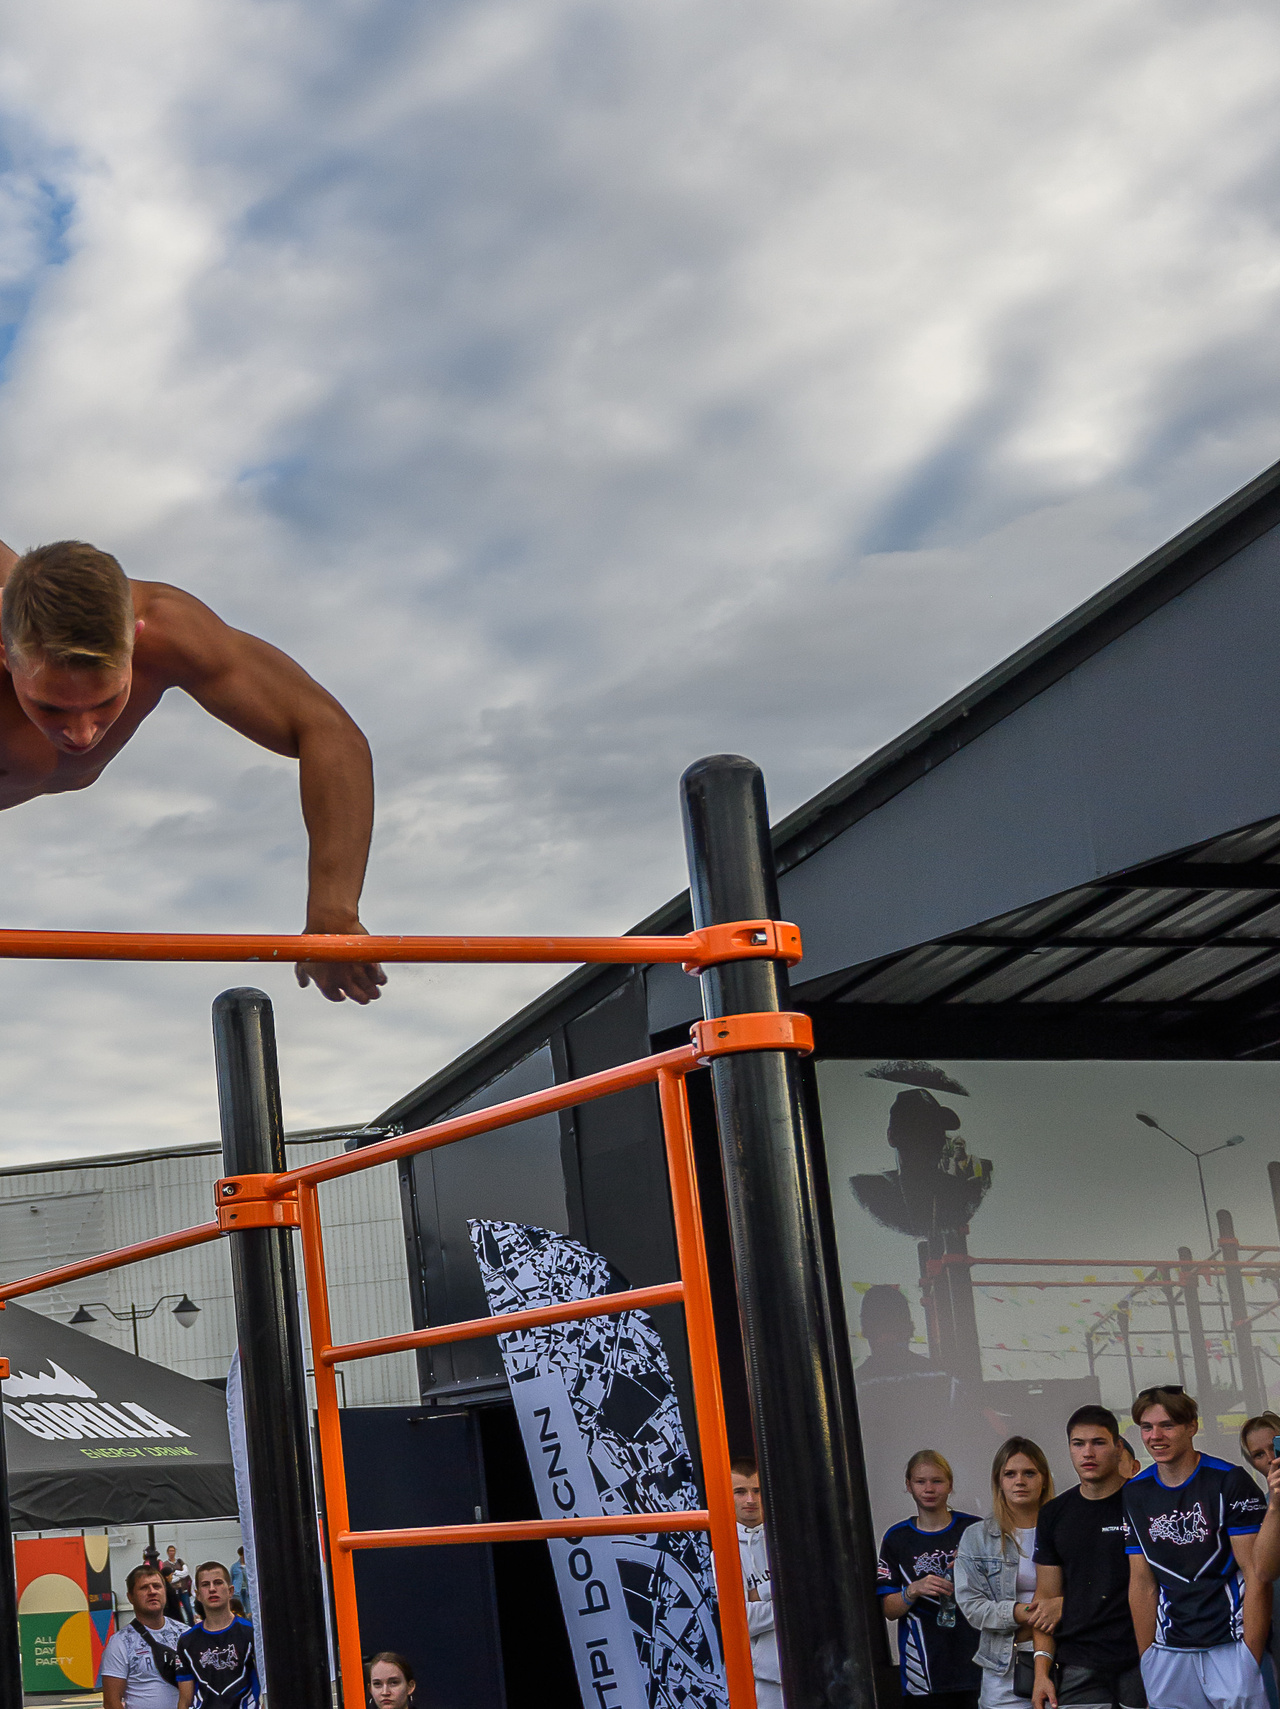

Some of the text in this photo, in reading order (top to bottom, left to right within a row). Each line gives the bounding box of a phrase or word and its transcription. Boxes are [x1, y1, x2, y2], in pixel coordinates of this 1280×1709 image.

[3, 1402, 191, 1440] GORILLA
[80, 1446, 199, 1459] ENERGY DRINK
[34, 1636, 56, 1644] ALL
[34, 1647, 56, 1656] DAY
[35, 1657, 74, 1666] PARTY
